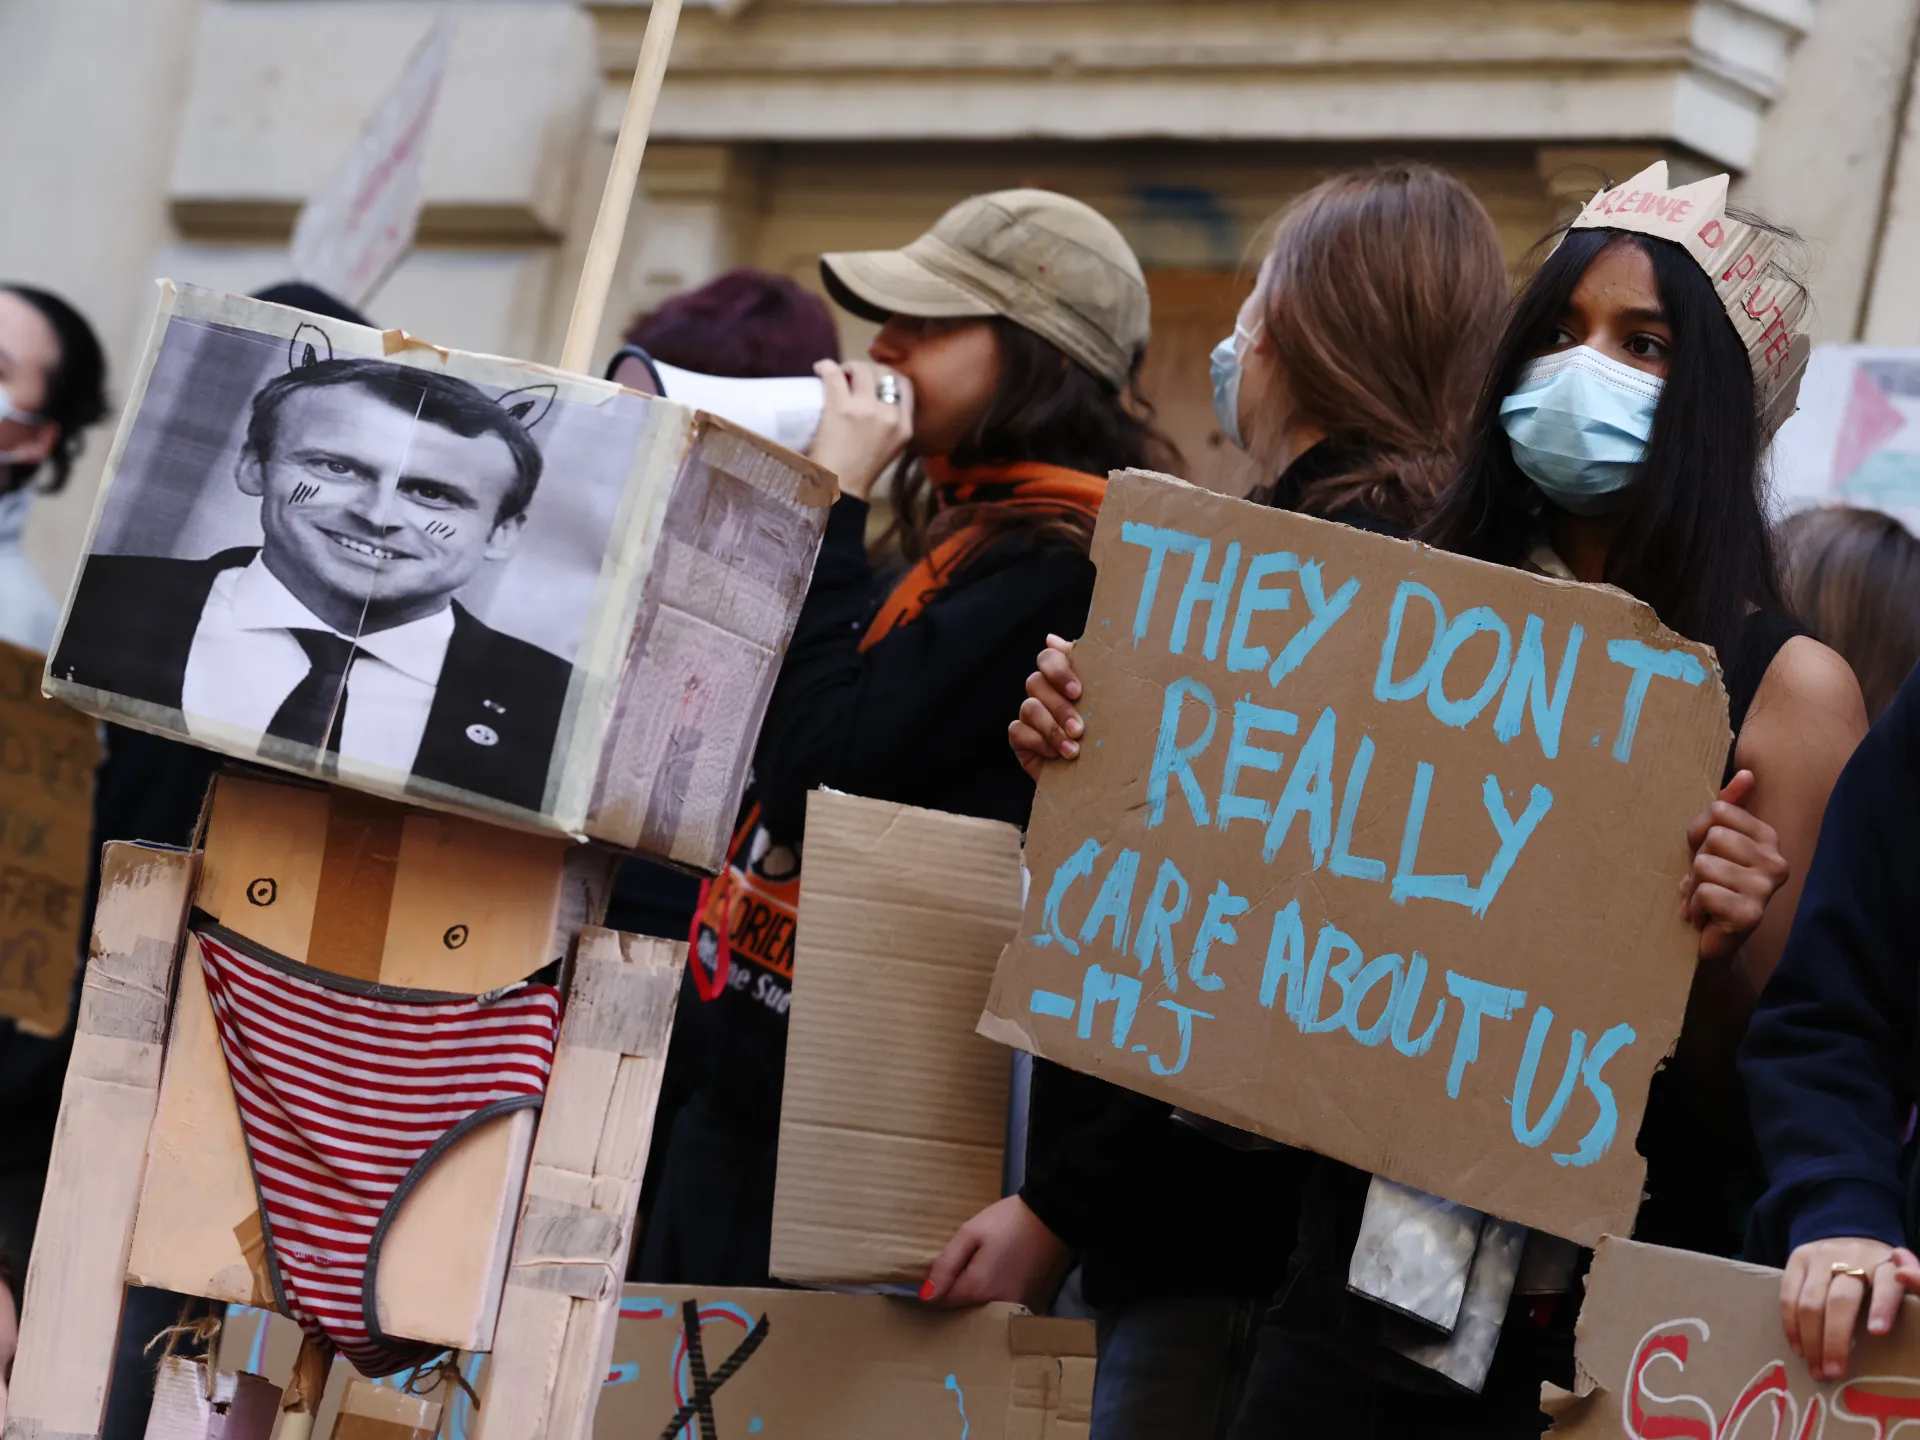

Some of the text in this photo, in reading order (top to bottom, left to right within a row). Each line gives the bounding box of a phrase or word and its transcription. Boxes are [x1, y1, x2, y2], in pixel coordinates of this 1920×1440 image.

[1594, 189, 1695, 224] REINE
[1120, 520, 1363, 689] THEY
[1144, 675, 1555, 920] REALLY
[1031, 837, 1637, 1168] CARE ABOUT US
